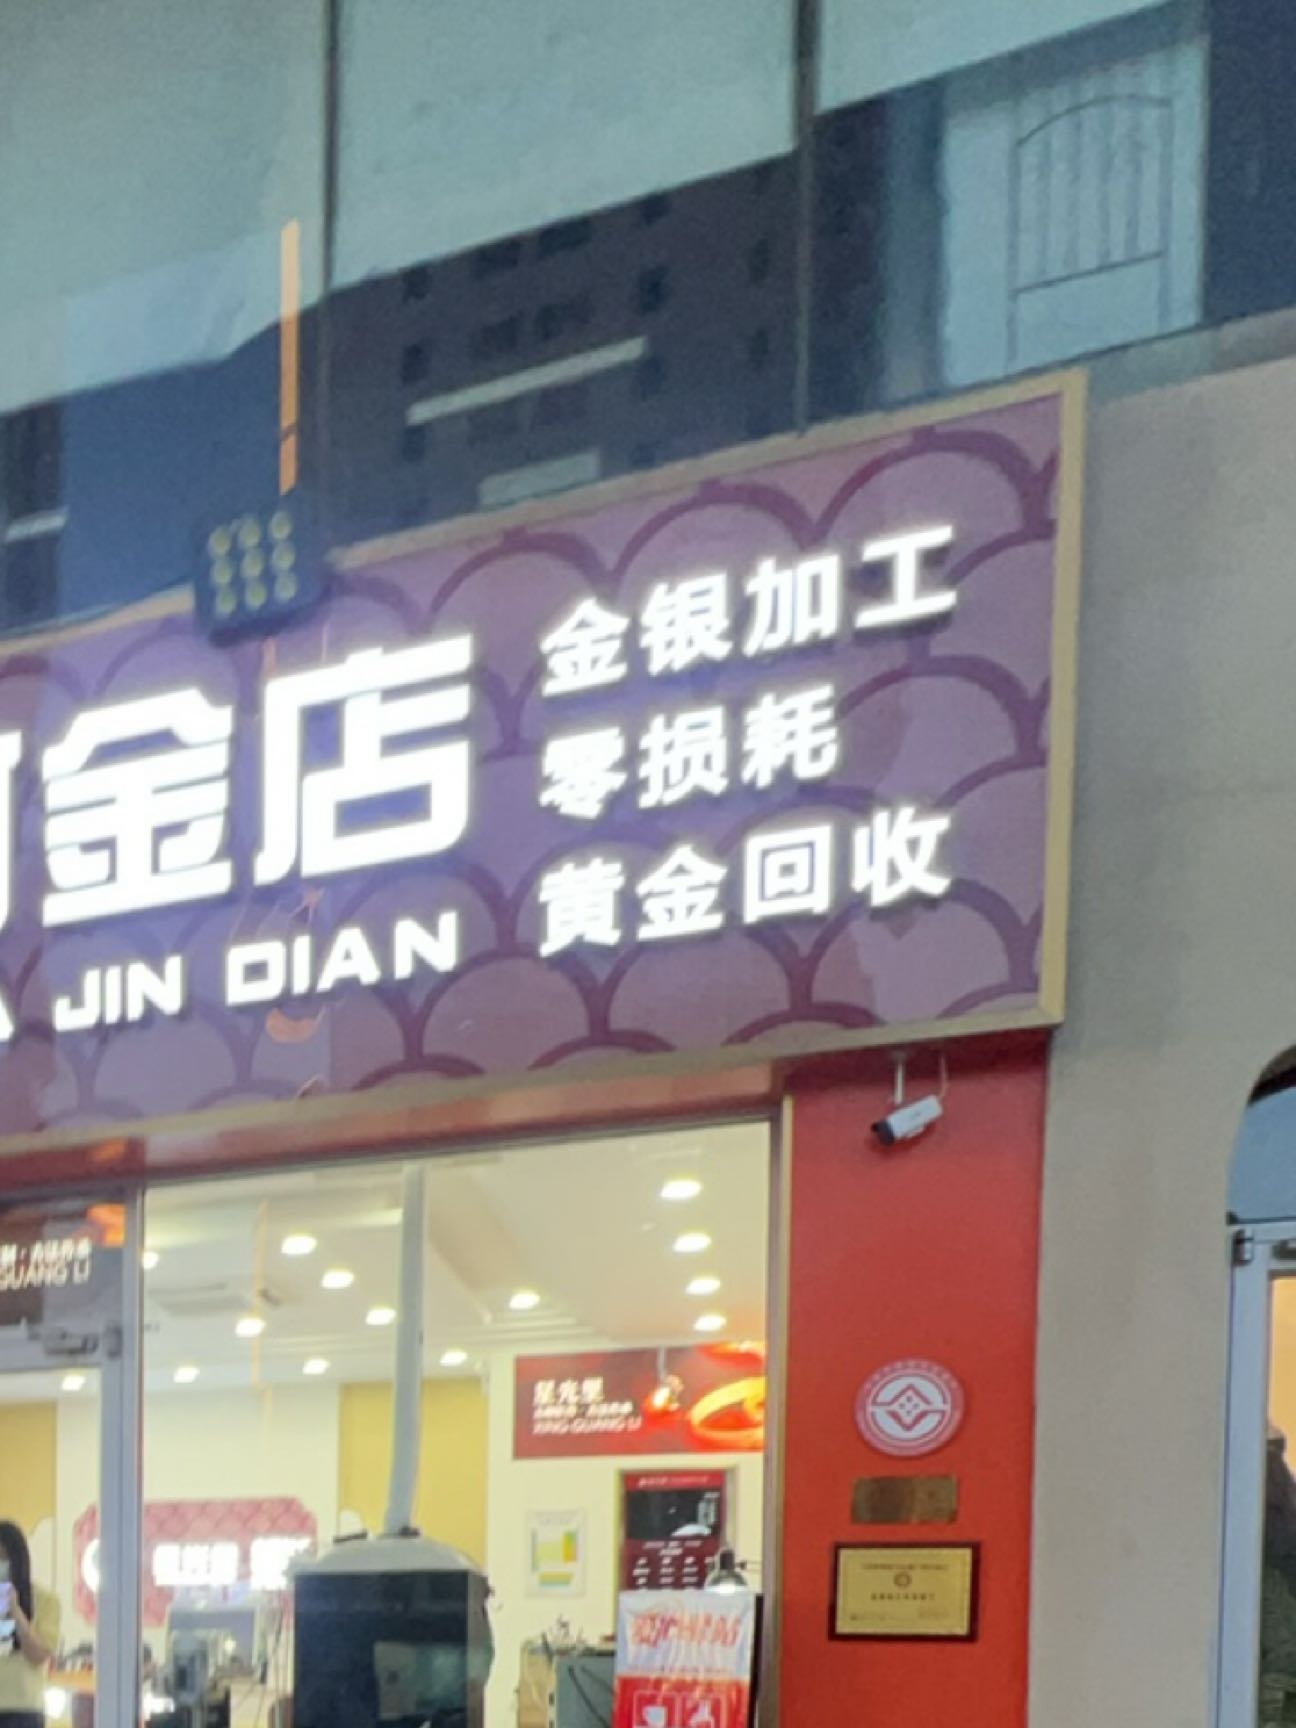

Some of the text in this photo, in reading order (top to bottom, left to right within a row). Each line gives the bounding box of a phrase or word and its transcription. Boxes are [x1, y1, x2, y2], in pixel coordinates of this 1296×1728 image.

[539, 525, 957, 697] 金银加工
[538, 684, 839, 820] 零损耗
[538, 806, 952, 959] 黄金回收
[54, 954, 182, 1032] JIN
[226, 911, 458, 1006] DIAN
